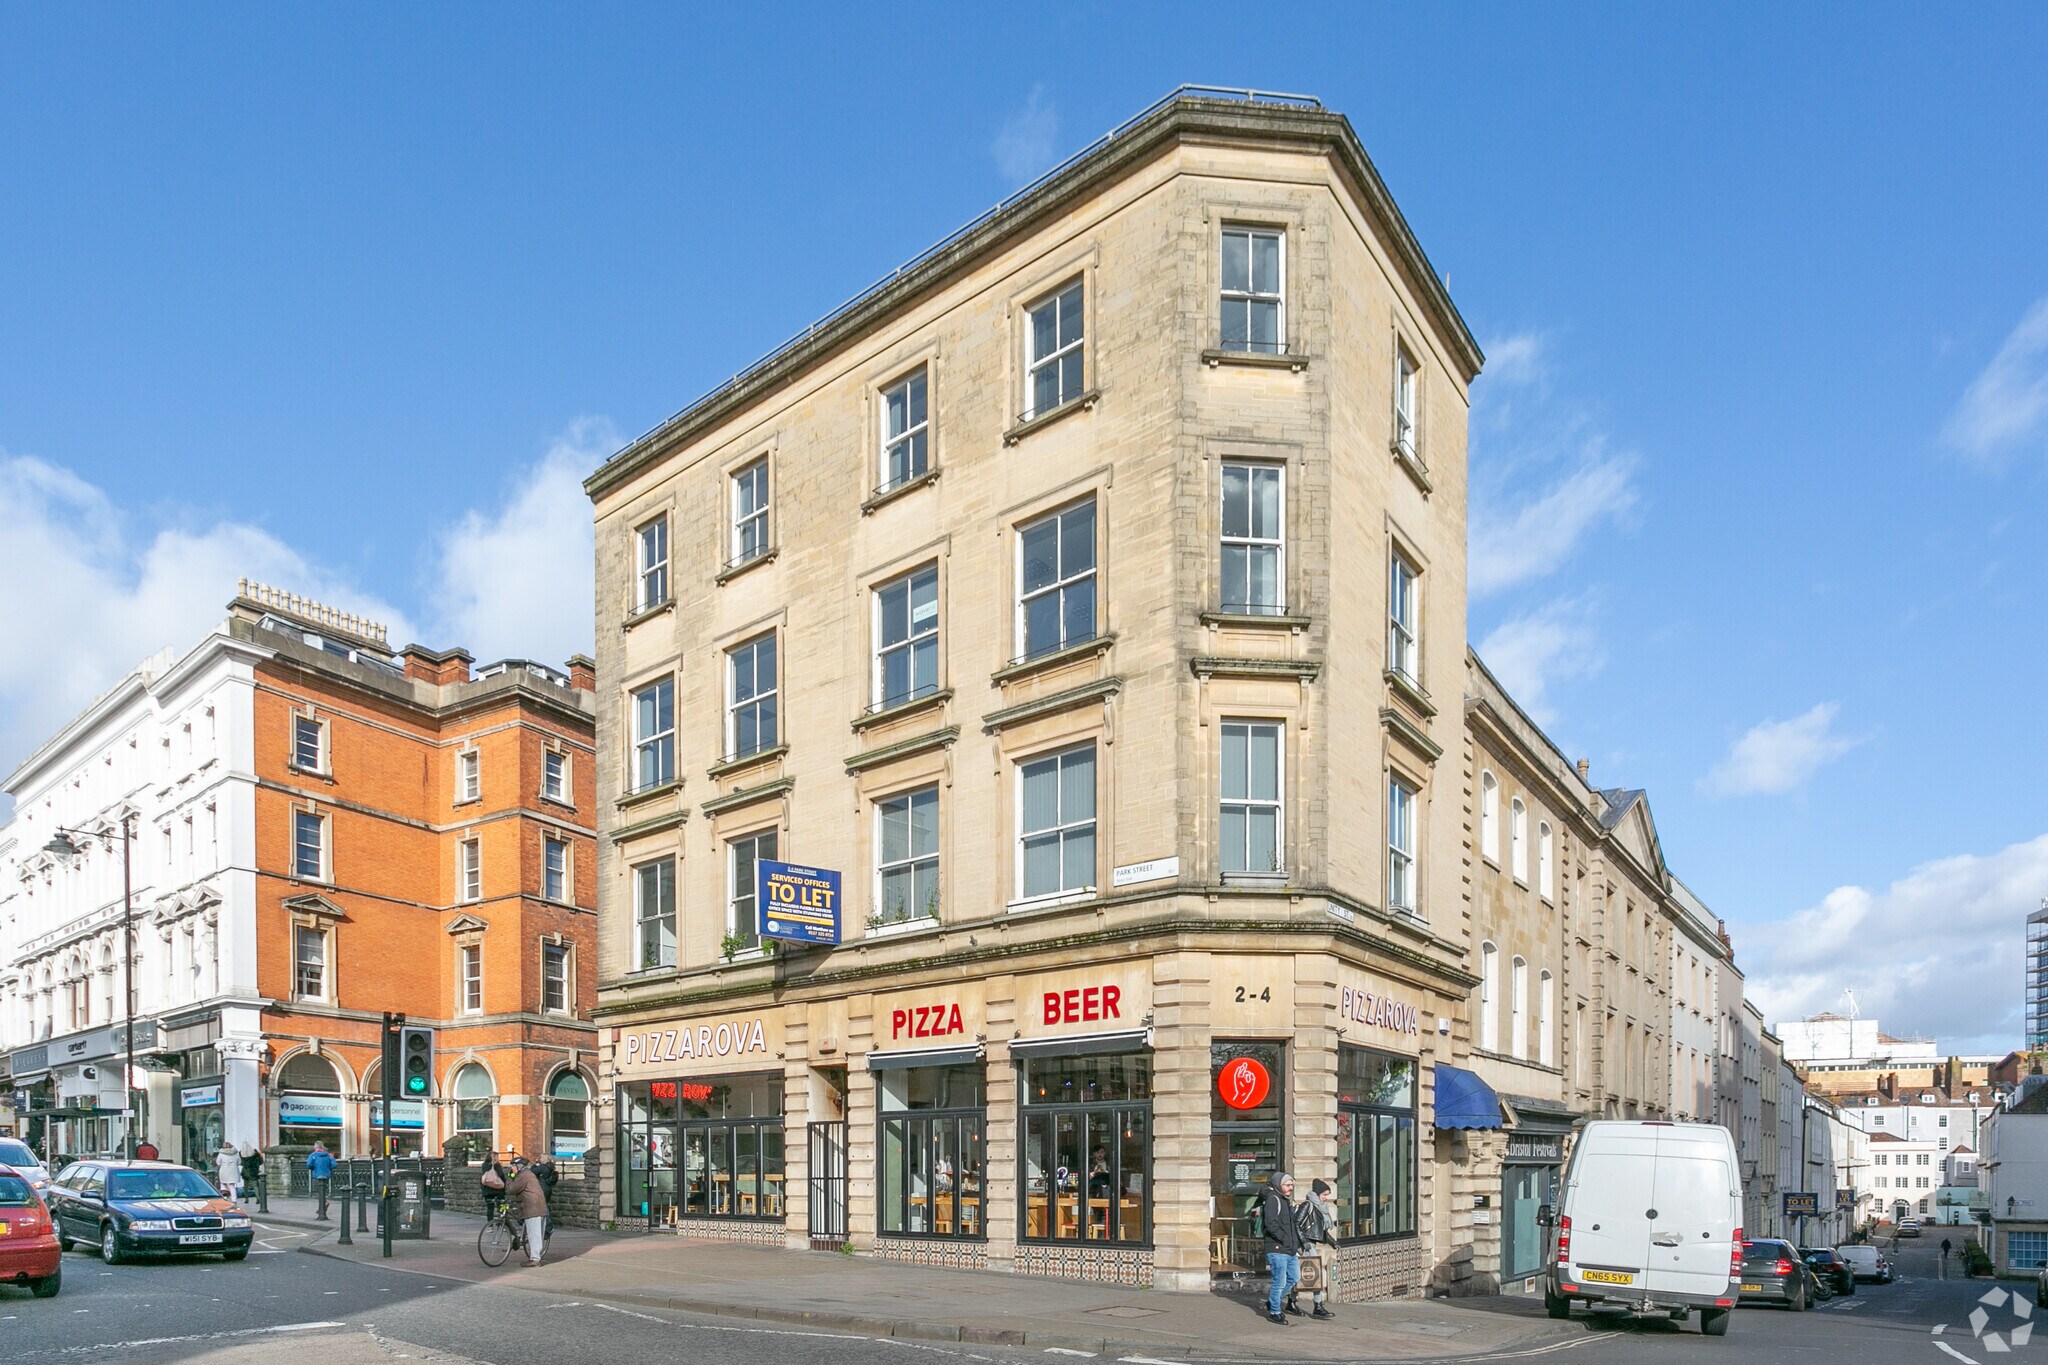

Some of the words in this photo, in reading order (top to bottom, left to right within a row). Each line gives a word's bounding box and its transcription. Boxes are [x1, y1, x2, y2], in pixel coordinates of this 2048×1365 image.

[771, 873, 803, 885] SERVICED
[804, 878, 830, 889] OFFICES
[1116, 868, 1131, 876] PARK
[1132, 864, 1153, 873] STREET
[767, 881, 795, 903] TO
[801, 886, 835, 908] LET
[1043, 985, 1121, 1026] BEER
[1235, 986, 1271, 1003] 2-4
[1341, 985, 1418, 1036] PIZZAROVA
[892, 1003, 965, 1041] PIZZA
[626, 1019, 767, 1064] PIZZAROVA
[391, 1107, 421, 1115] personnel
[1510, 1135, 1531, 1157] Bristol
[1532, 1136, 1557, 1157] Festivals
[1586, 1271, 1610, 1281] CN65
[1611, 1273, 1629, 1282] SYX
